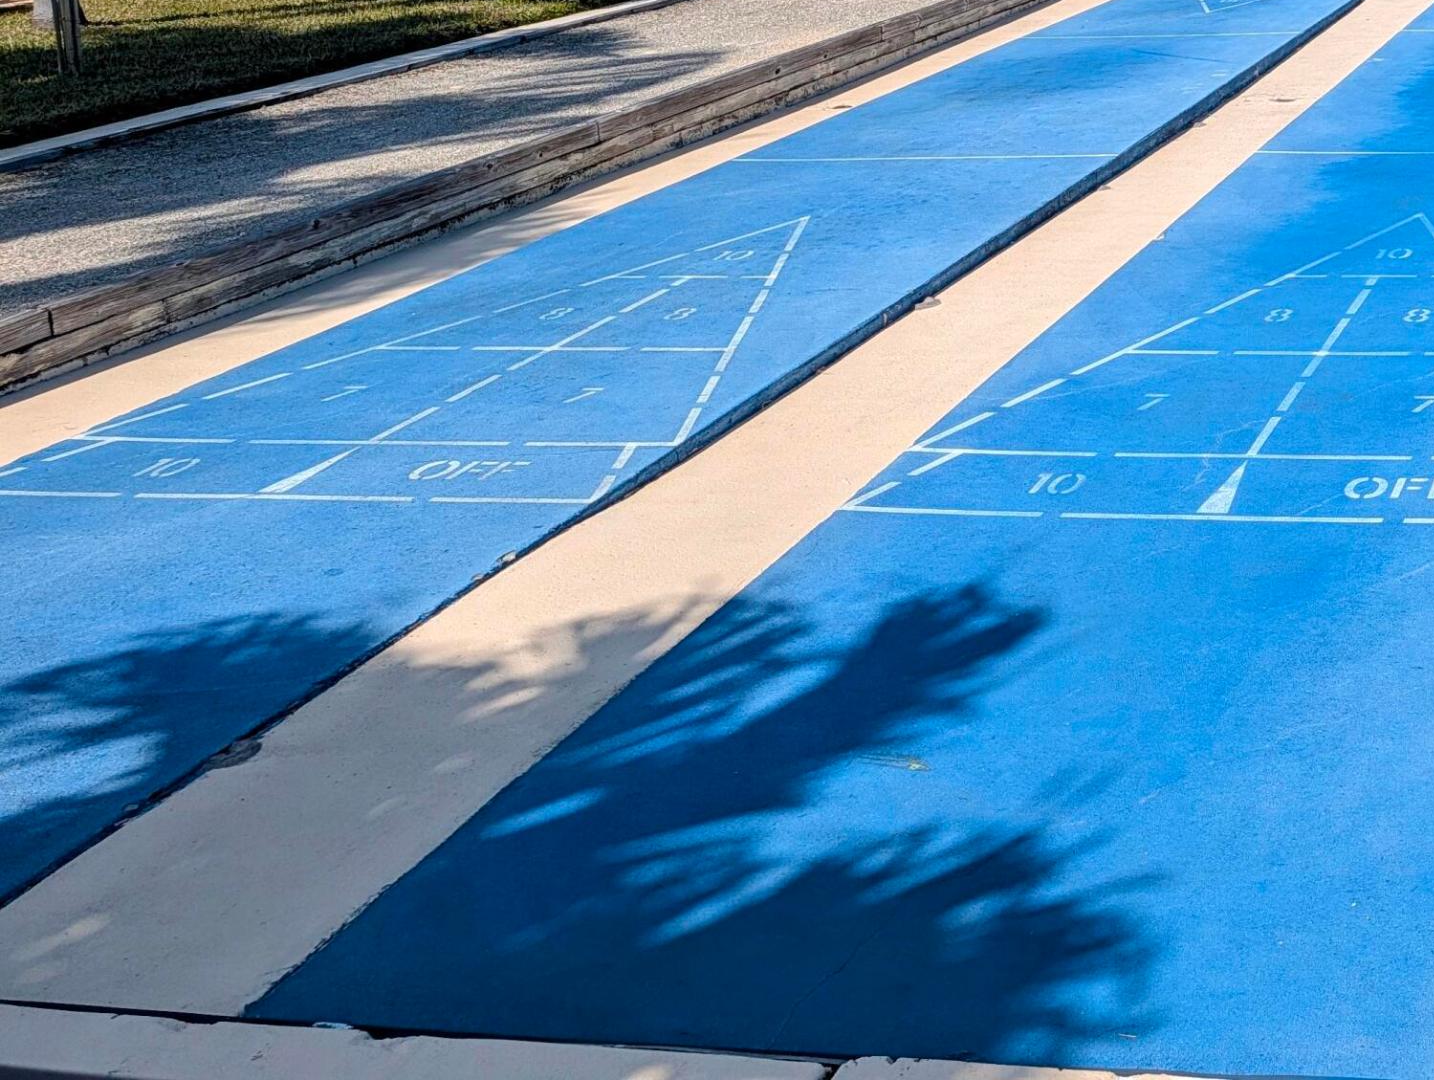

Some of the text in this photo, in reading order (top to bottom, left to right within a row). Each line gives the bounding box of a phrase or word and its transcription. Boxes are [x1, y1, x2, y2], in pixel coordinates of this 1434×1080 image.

[713, 251, 755, 261] 10
[1376, 248, 1413, 259] 10
[538, 307, 573, 320] 8
[664, 308, 696, 320] 8
[1264, 309, 1293, 322] 8
[1403, 309, 1431, 322] 8
[1138, 393, 1169, 410] 7
[133, 458, 531, 480] 10 OFF
[1029, 473, 1085, 493] 10
